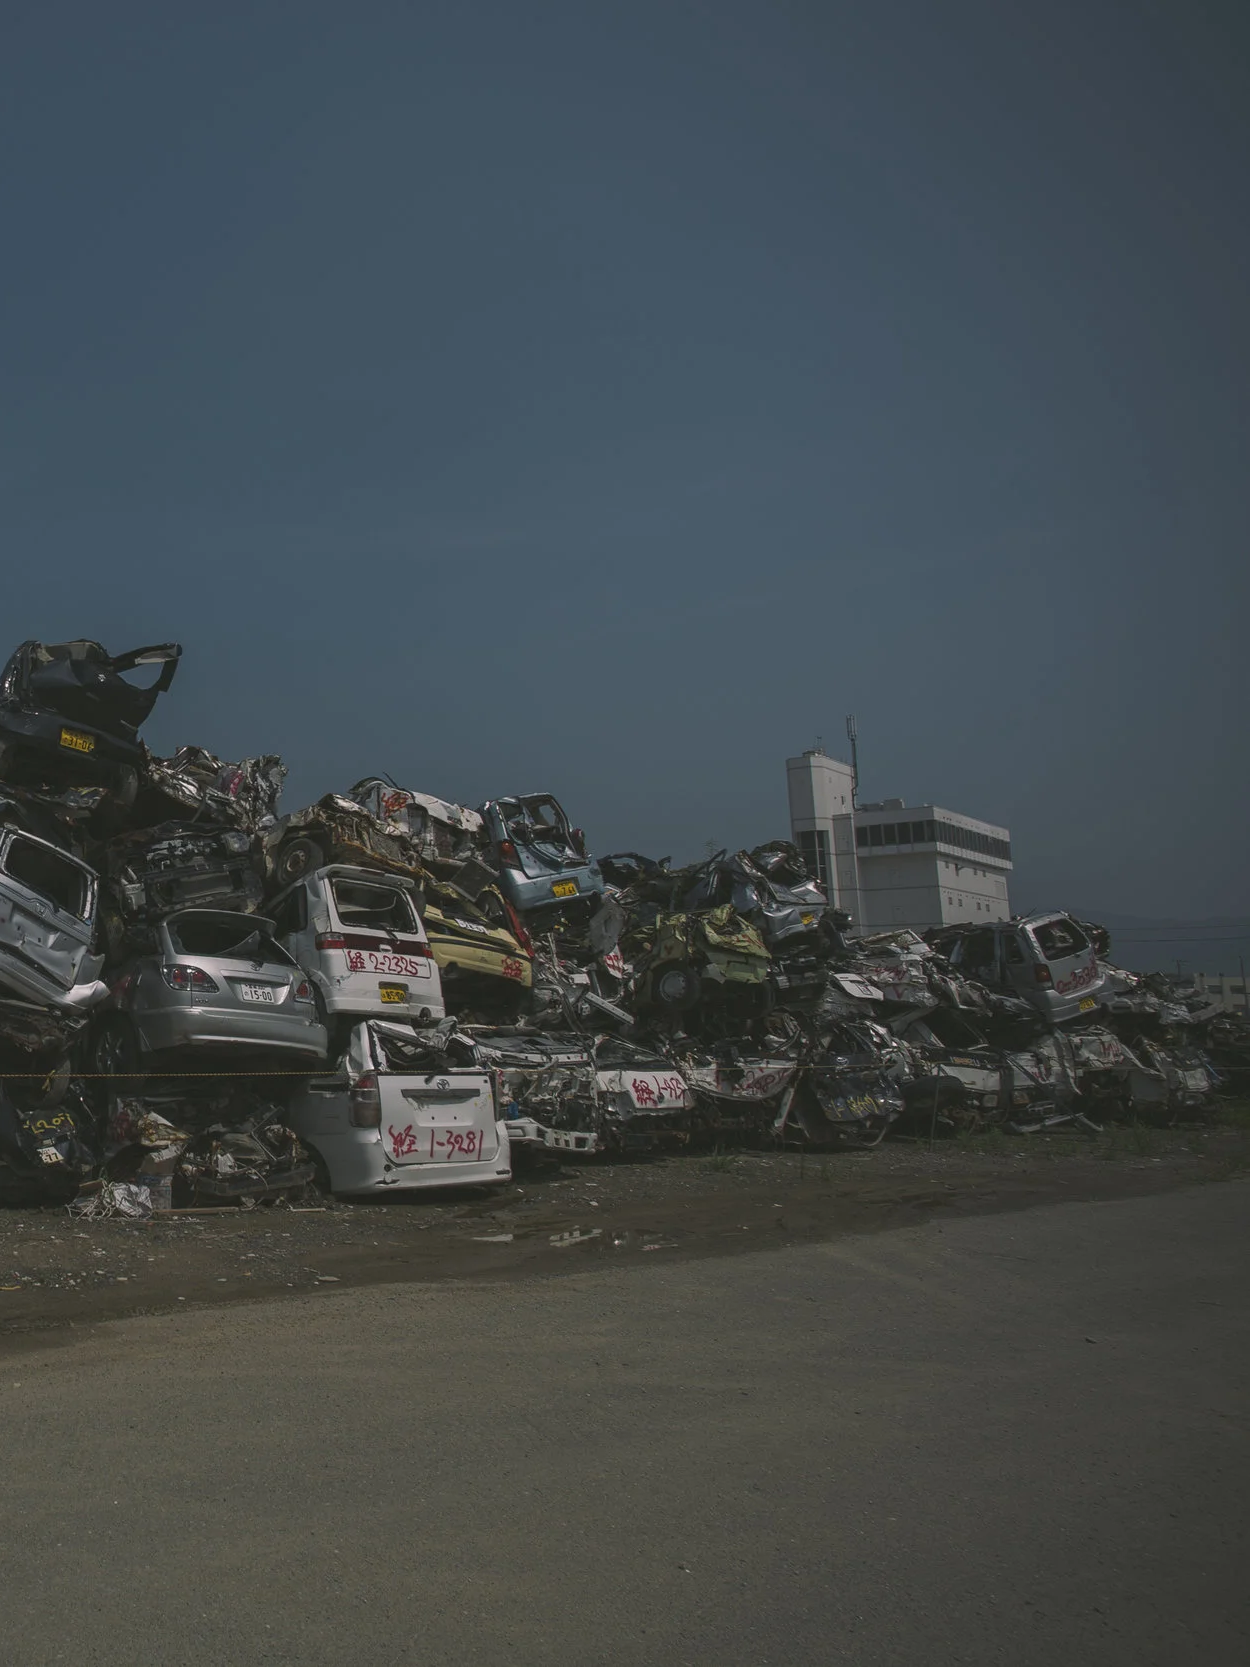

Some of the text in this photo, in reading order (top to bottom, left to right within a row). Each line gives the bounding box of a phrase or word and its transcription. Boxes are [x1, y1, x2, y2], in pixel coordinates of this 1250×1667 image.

[368, 952, 419, 976] 2-2325
[250, 989, 273, 1002] 15-00
[429, 1128, 484, 1161] 1-3281
